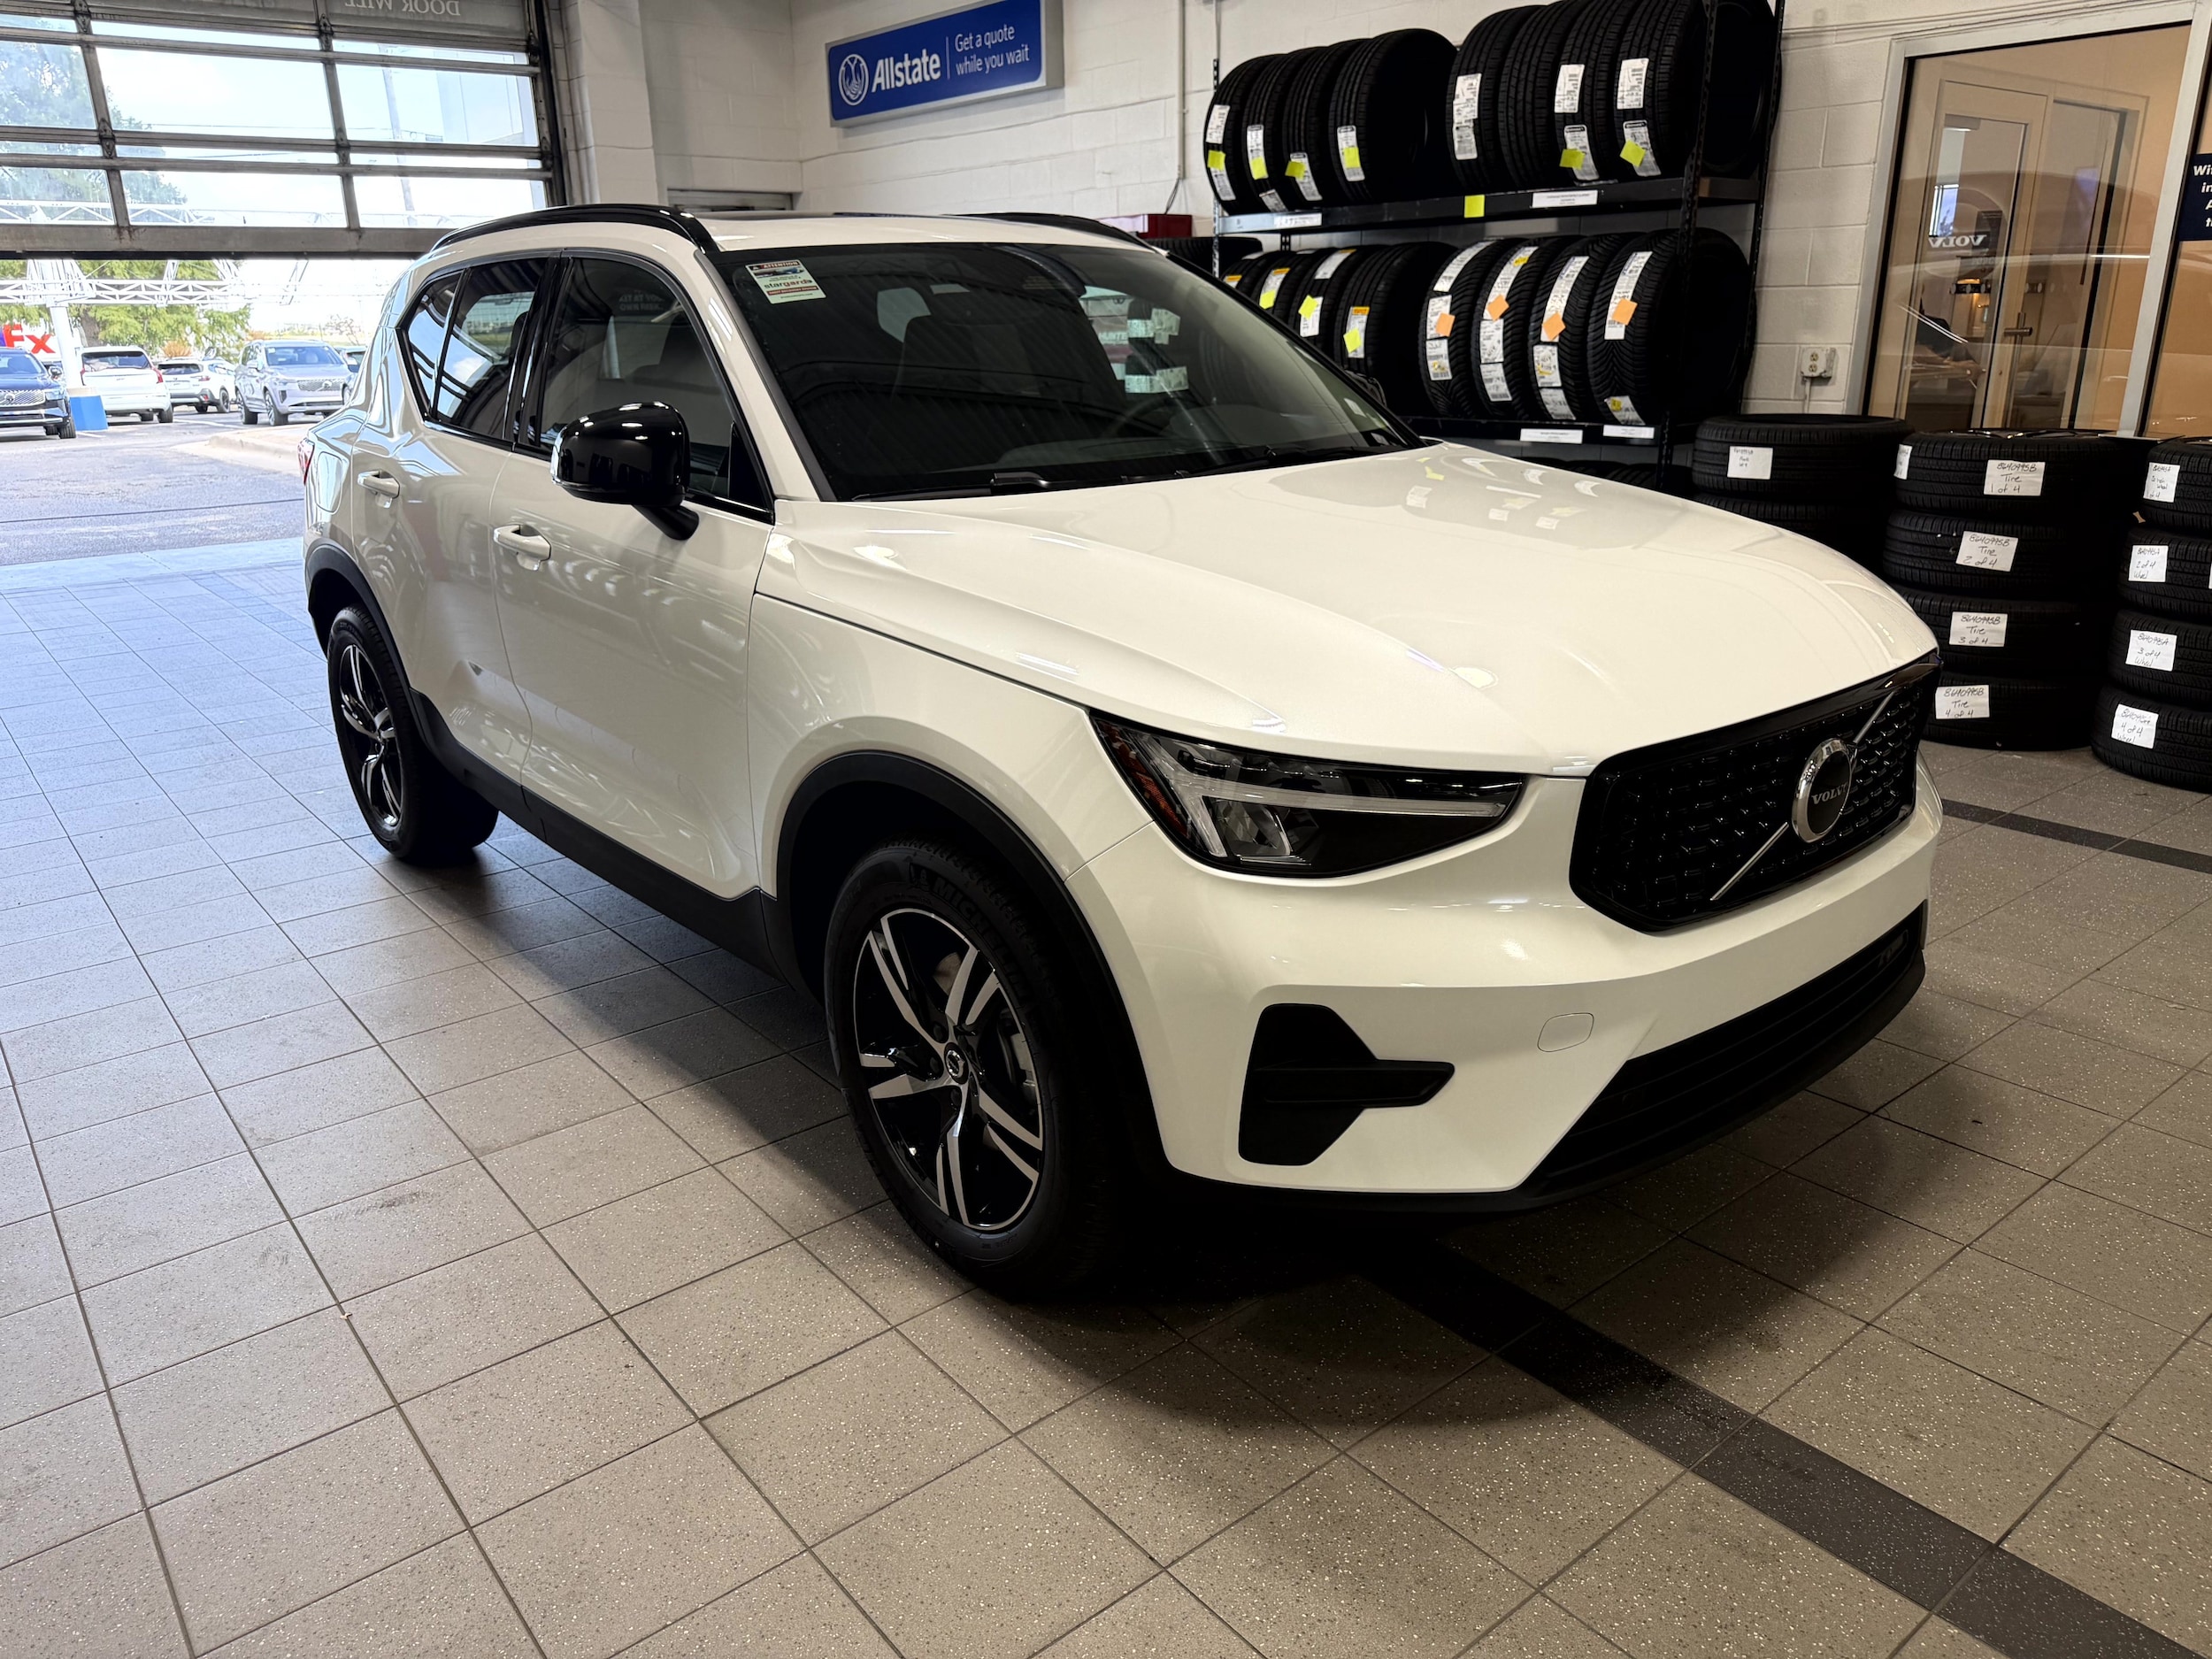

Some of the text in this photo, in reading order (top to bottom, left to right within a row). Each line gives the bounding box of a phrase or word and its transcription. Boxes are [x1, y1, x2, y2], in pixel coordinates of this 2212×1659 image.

[955, 23, 1015, 52] Get a quote
[956, 43, 1030, 75] while you wait
[872, 49, 941, 93] Allstate
[2193, 165, 2212, 176] Wi
[2001, 472, 2023, 482] Tire
[1997, 483, 2008, 493] of
[2013, 485, 2021, 494] 4
[1978, 546, 1997, 557] Tire
[1962, 556, 1998, 568] 2 of 4
[2141, 559, 2149, 568] of
[2149, 560, 2156, 569] 4
[1966, 626, 1985, 634] Tire
[1969, 636, 1978, 645] of
[1952, 699, 1970, 709] Tire
[1945, 709, 1951, 718] 4
[1967, 709, 1974, 718] 4
[2121, 722, 2144, 737] 4 of 4
